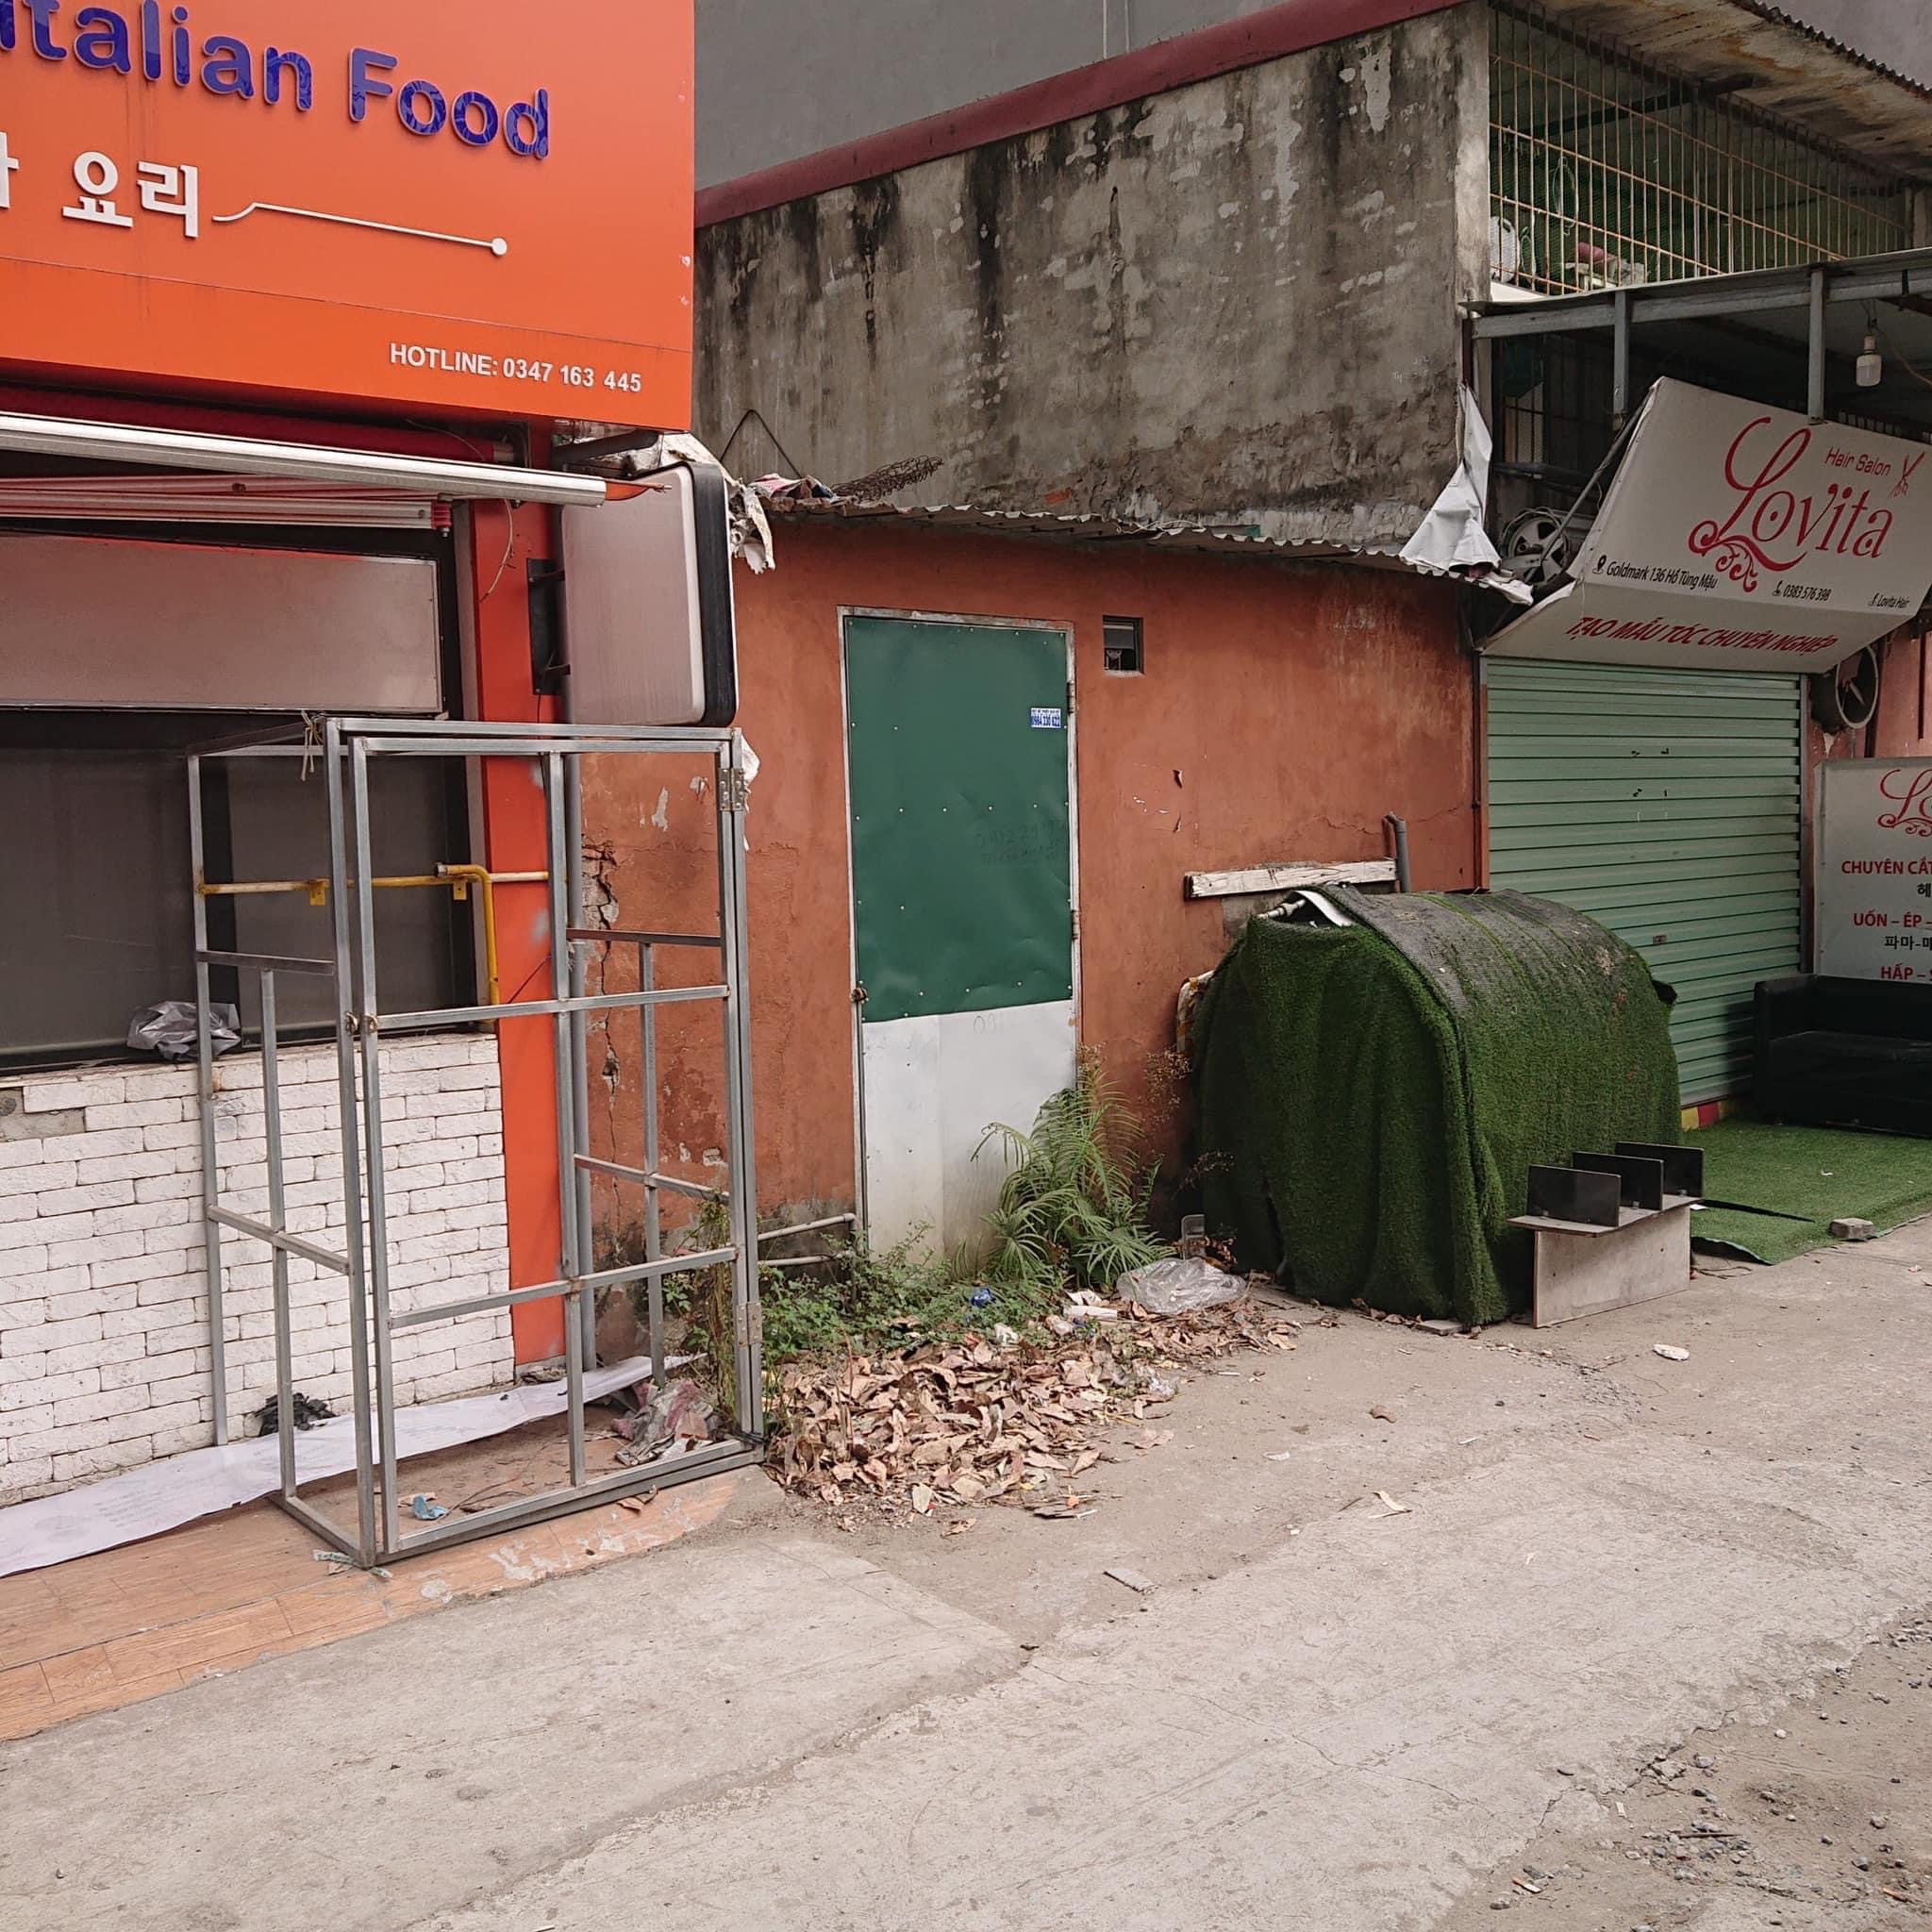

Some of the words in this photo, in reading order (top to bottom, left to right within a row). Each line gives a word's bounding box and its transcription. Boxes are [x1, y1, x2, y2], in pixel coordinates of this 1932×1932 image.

[348, 47, 550, 159] Food
[61, 150, 198, 239] 요리
[390, 342, 499, 376] HOTLINE:
[503, 358, 554, 382] 0347
[559, 365, 594, 387] 163
[603, 370, 642, 392] 445
[1824, 445, 1855, 469] Hair
[1856, 454, 1892, 476] Salon
[1688, 416, 1894, 585] Lovita
[1607, 560, 1650, 581] Goldmark
[1649, 566, 1666, 583] 136
[1840, 858, 1905, 875] CHUYÊN
[1853, 908, 1888, 927] UỐN
[1903, 911, 1923, 928] ÉP
[1880, 962, 1914, 980] HẤP
